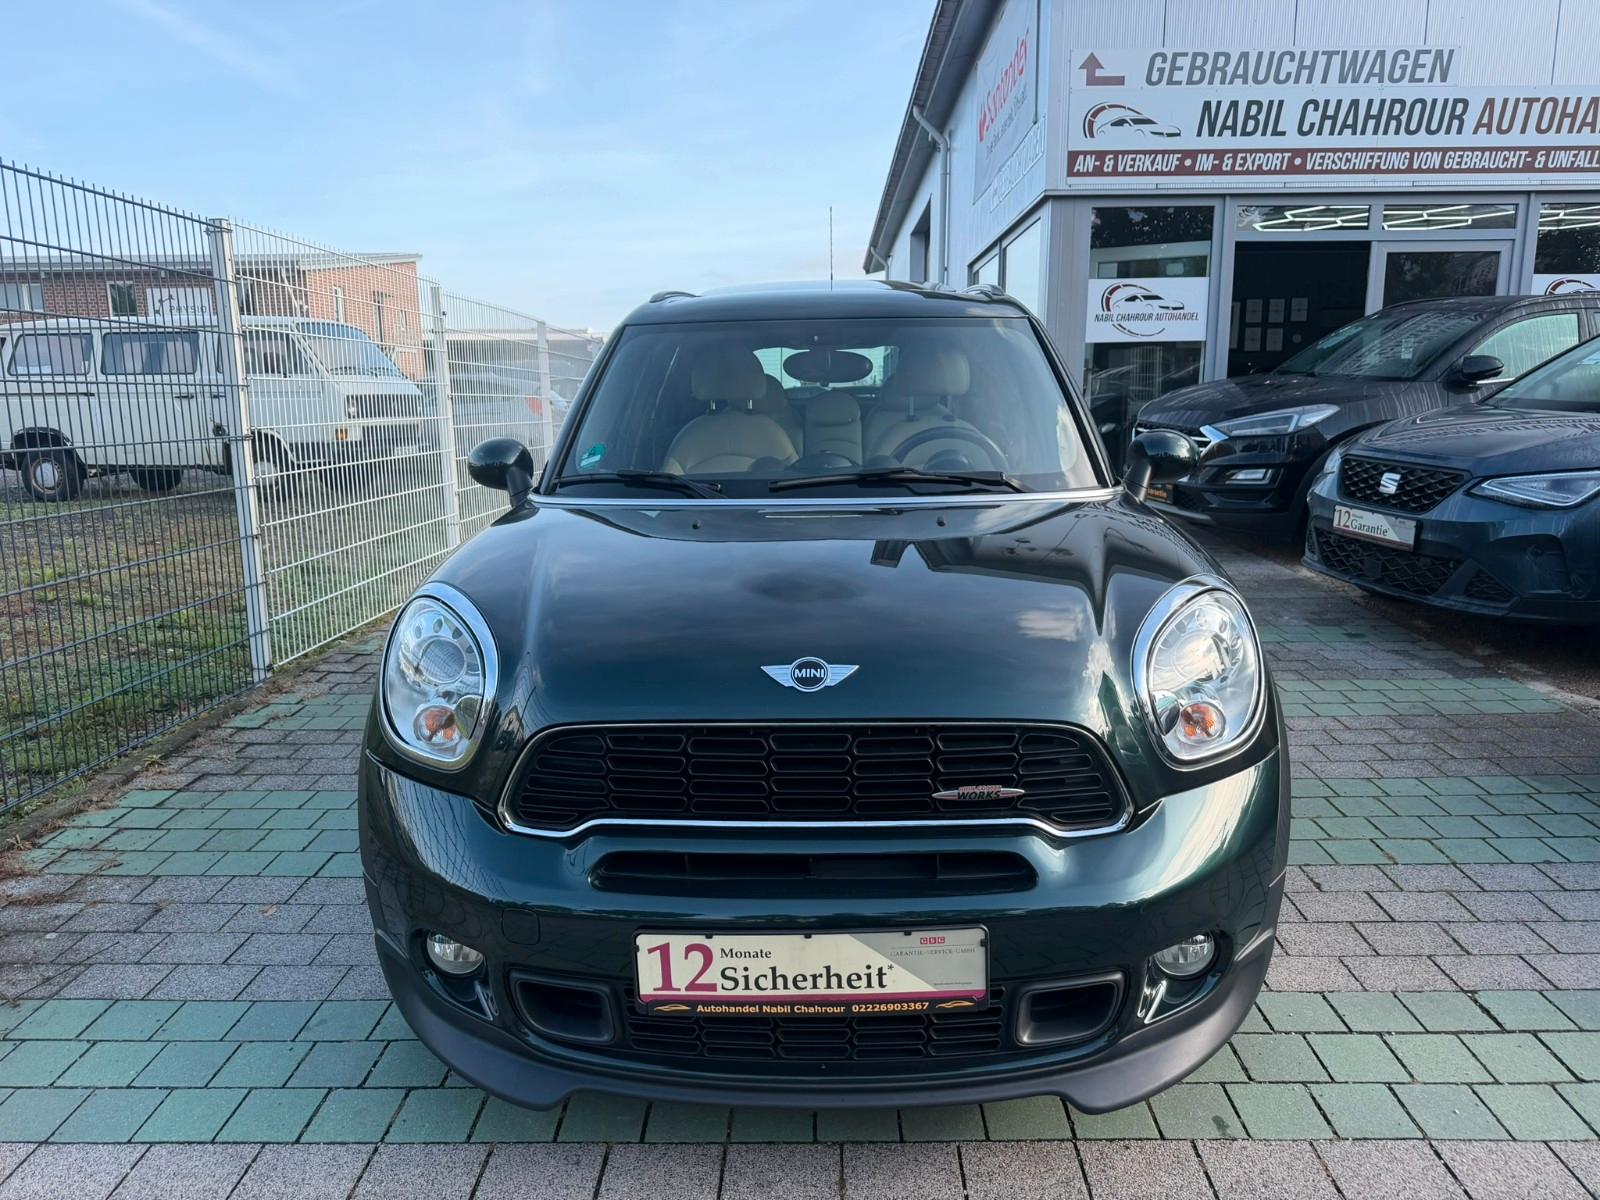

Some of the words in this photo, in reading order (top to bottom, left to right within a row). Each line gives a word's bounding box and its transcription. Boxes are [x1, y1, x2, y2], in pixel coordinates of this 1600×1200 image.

[1145, 48, 1454, 87] GEBRAUCHTWAGEN
[1196, 99, 1288, 137] NABIL
[1297, 97, 1470, 137] CHAHROUR
[1472, 96, 1600, 135] AUTOHA
[1073, 154, 1100, 173] AN-
[1103, 154, 1118, 172] &
[1117, 153, 1182, 172] VERKAUF
[1195, 153, 1220, 171] IM-
[1222, 152, 1234, 171] &
[1234, 152, 1292, 171] EXPORT
[1306, 151, 1411, 171] VERSCHIFFUNG
[1412, 151, 1442, 170] VON
[1444, 150, 1532, 170] GEBRAUCHT-
[1534, 151, 1546, 169] &
[1094, 313, 1114, 323] NABIL
[1116, 312, 1153, 322] CHAHROUR
[1154, 311, 1200, 321] AUTOHANDEL
[1335, 509, 1351, 529] 12
[794, 668, 825, 678] MINI
[957, 790, 1001, 800] WORKS
[647, 942, 718, 992] 12
[720, 947, 772, 960] Monate
[696, 1003, 760, 1013] Autohandel
[762, 1003, 791, 1013] Nabil
[793, 1003, 846, 1013] Chahrour
[851, 1001, 930, 1013] 02226903367
